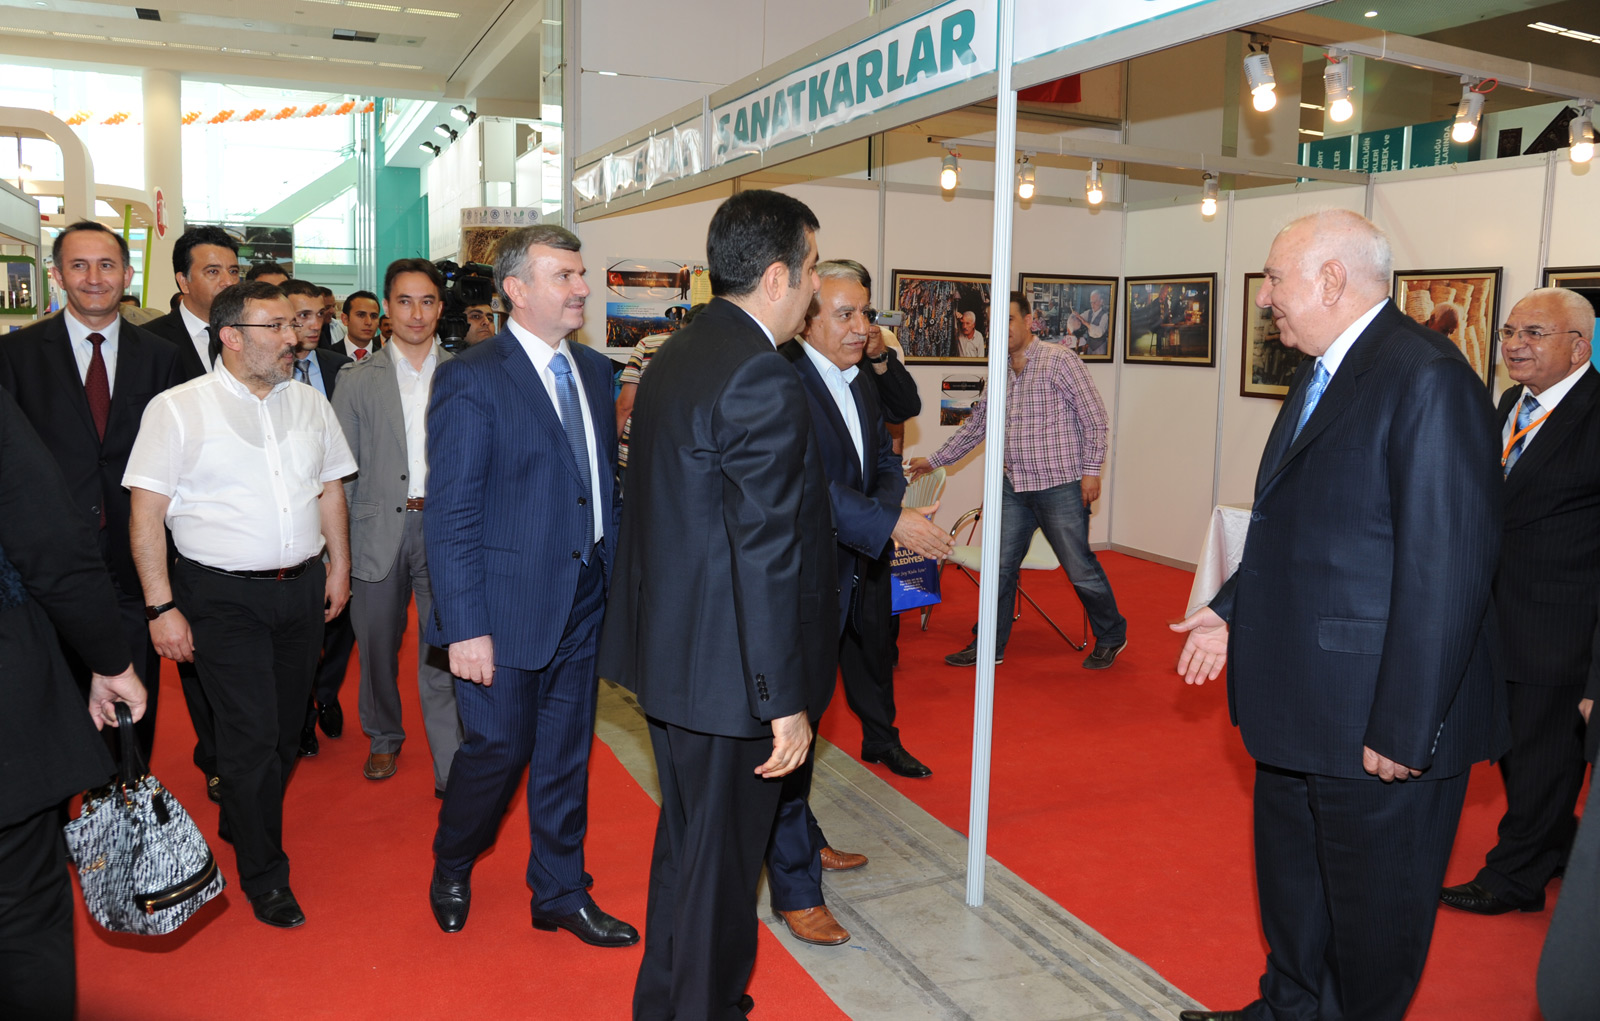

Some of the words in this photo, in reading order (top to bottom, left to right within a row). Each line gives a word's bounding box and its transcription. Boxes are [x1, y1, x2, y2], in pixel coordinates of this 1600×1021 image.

[1434, 139, 1442, 165] NLUĞU
[1442, 125, 1451, 164] LARINDA
[1381, 147, 1389, 172] EBEK
[894, 549, 914, 558] KULU
